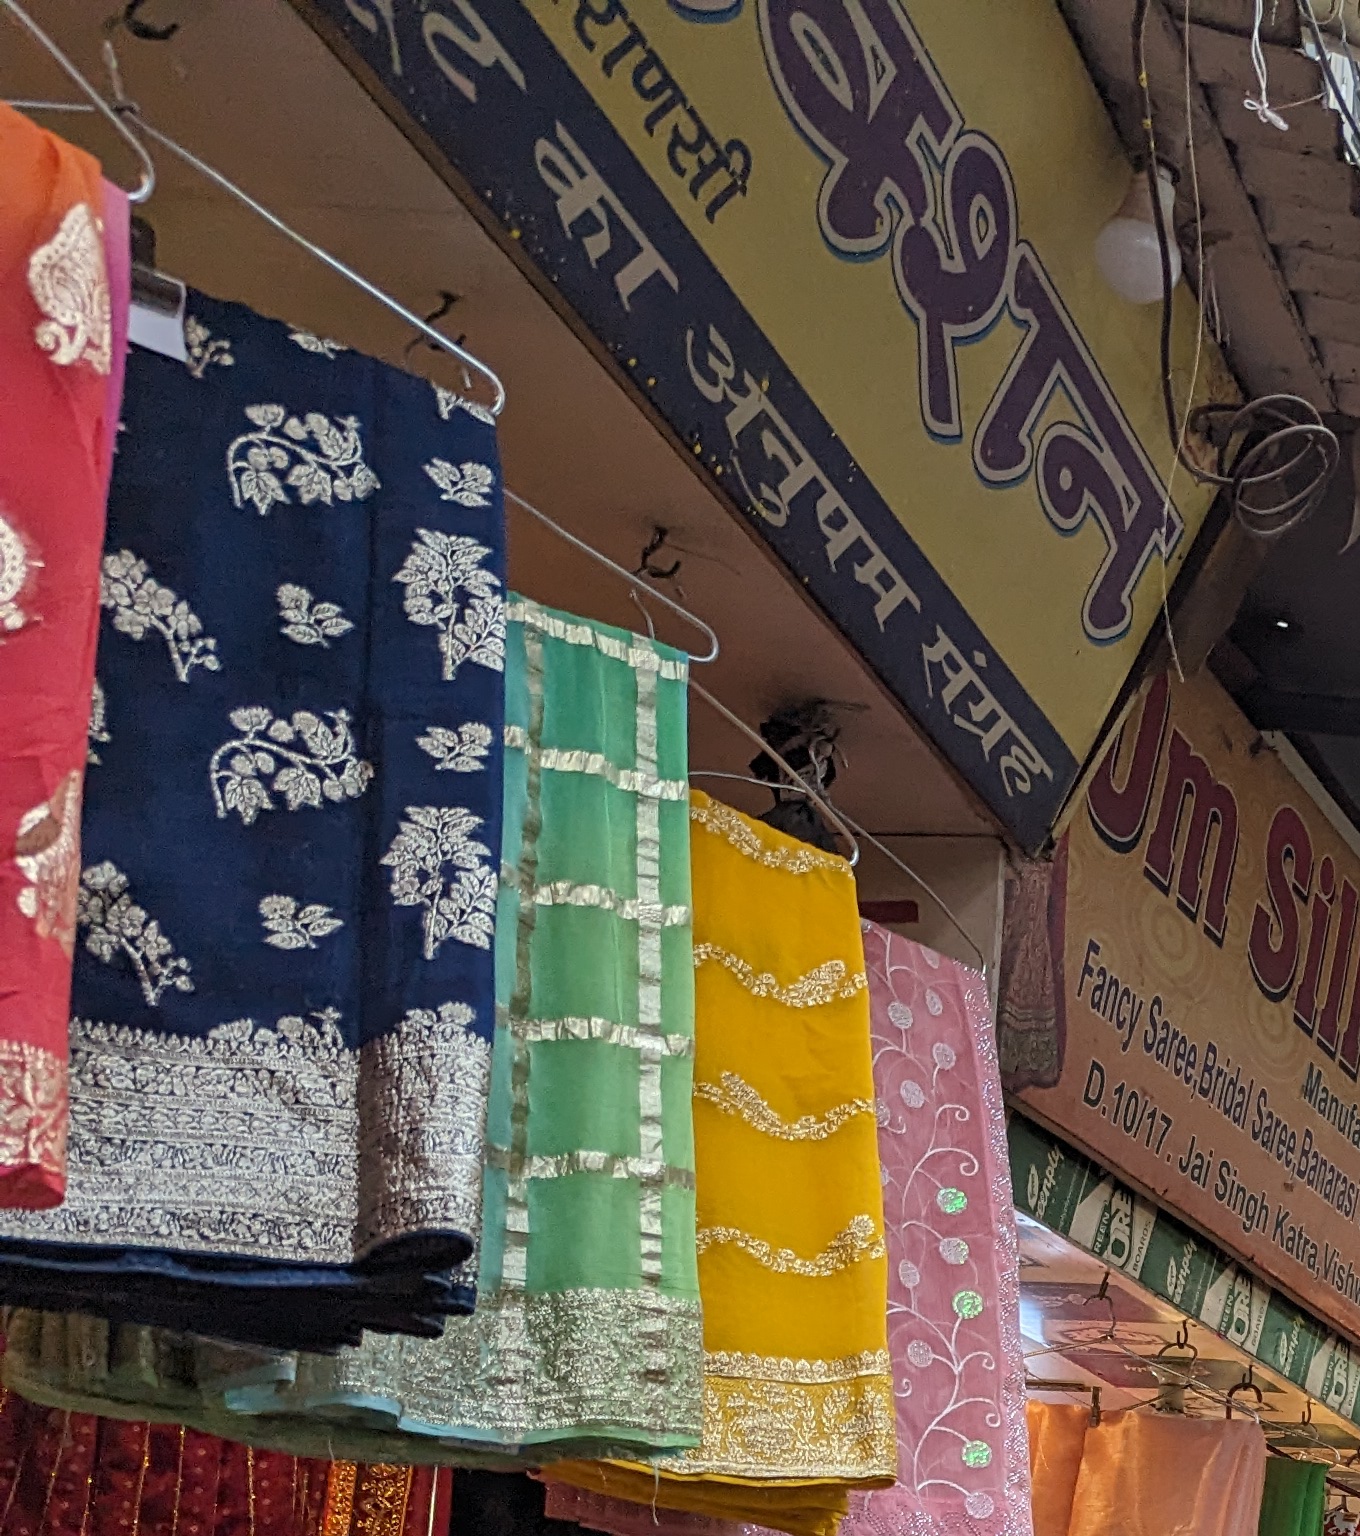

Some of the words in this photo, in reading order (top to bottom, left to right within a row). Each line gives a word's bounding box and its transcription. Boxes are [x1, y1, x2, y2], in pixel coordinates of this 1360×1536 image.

[534, 121, 679, 311] का
[686, 324, 921, 636] अनुपम
[921, 623, 1054, 798] संग्रह
[1077, 938, 1144, 1053] Fancy
[1178, 1135, 1215, 1190] Jai
[1214, 1159, 1270, 1236] Singh
